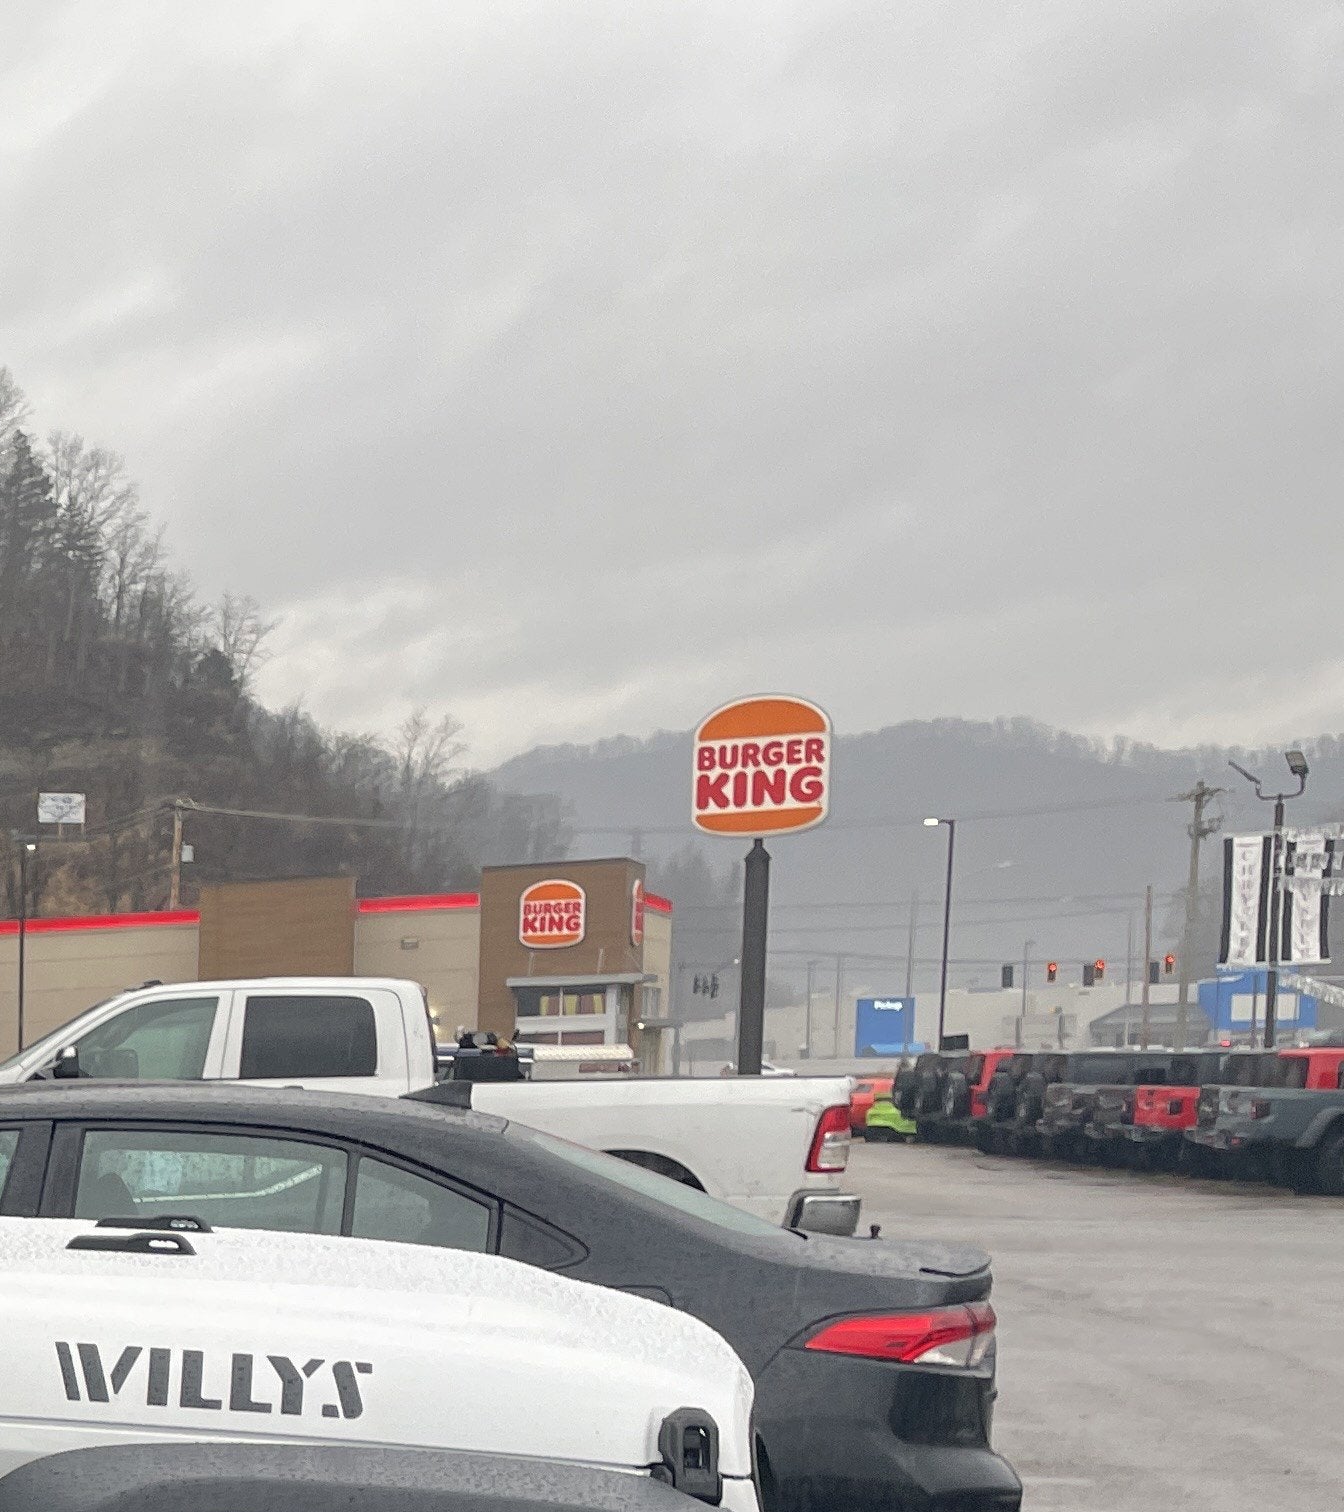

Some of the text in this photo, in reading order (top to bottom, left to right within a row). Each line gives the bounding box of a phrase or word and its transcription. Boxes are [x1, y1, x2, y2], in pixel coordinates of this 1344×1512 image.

[697, 738, 825, 771] BURGER
[696, 766, 824, 810] KING
[522, 915, 581, 933] KING
[523, 901, 581, 916] BURGER
[55, 1341, 373, 1419] WILLYS
